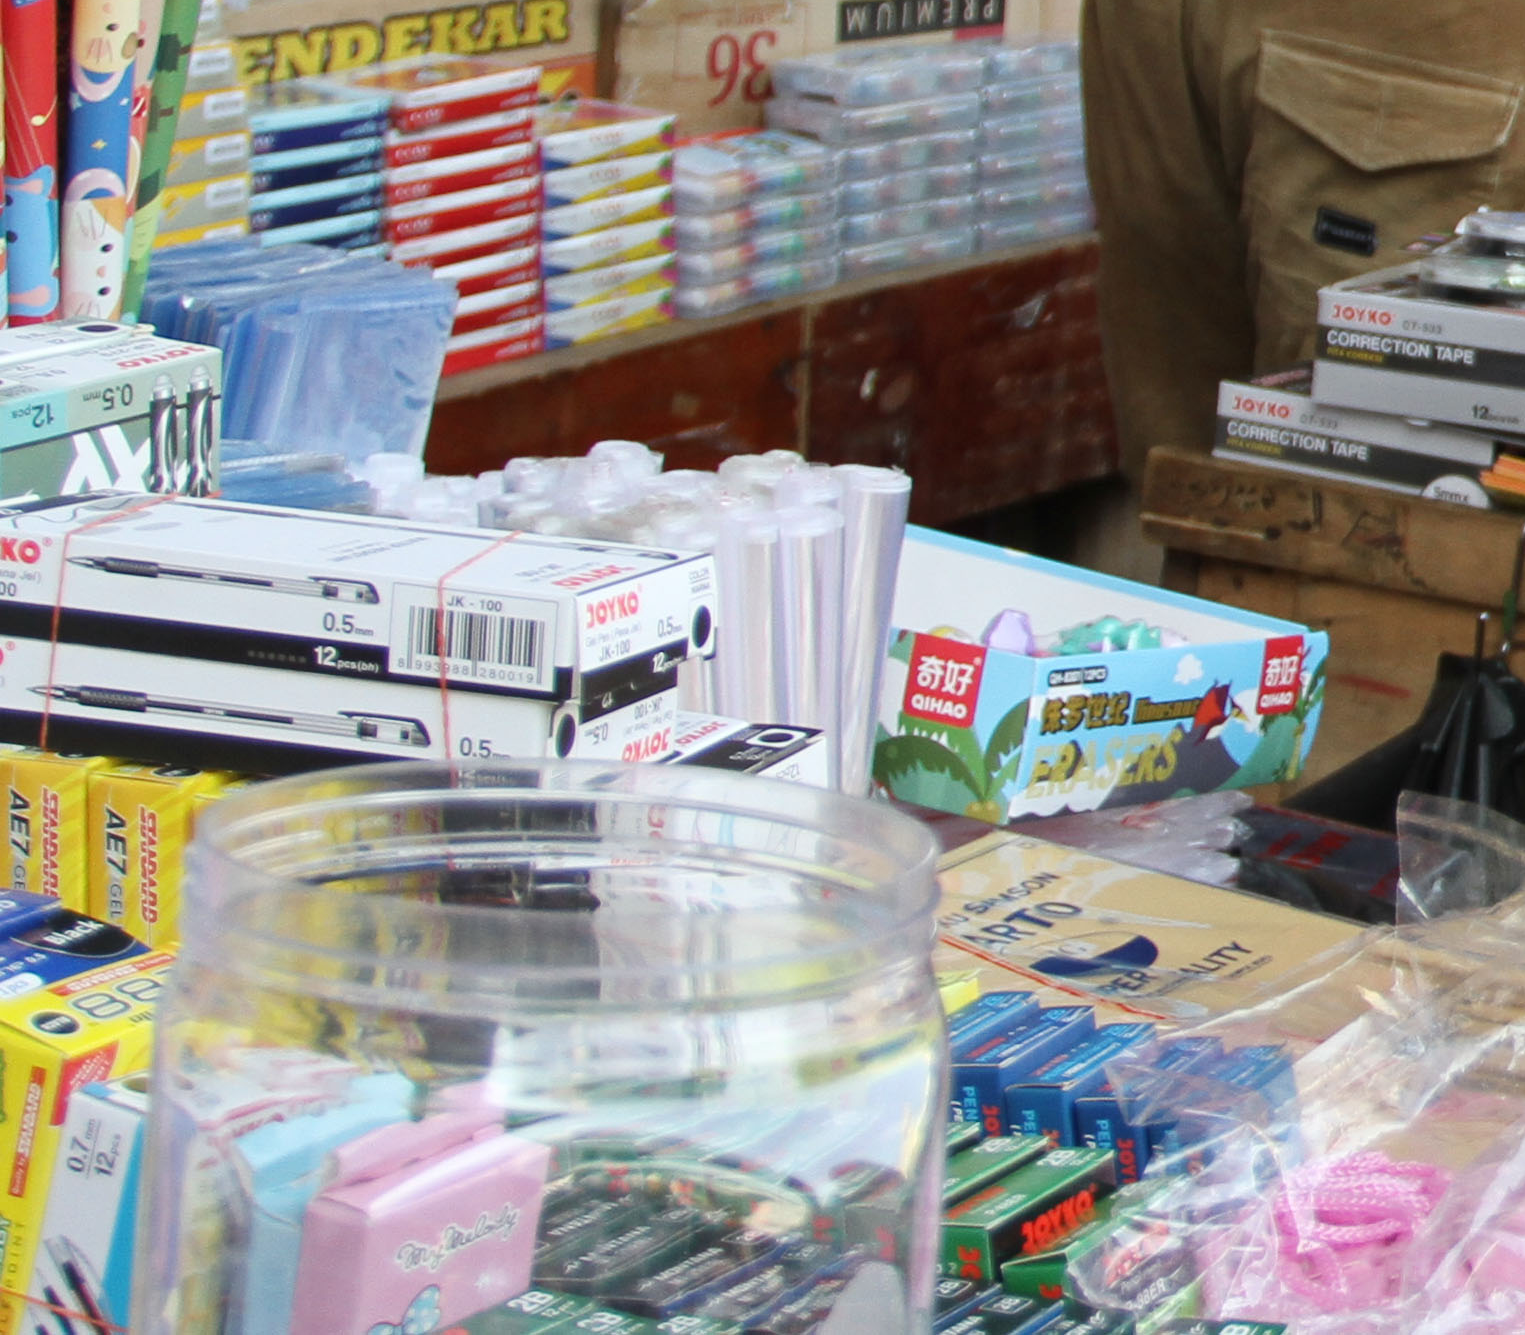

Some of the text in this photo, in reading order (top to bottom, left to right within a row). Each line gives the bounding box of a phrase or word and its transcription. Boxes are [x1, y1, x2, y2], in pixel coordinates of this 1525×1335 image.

[1332, 303, 1392, 327] JOYKO
[1326, 329, 1475, 364] CORRECTION TAPE
[1232, 395, 1290, 419] JOYKO
[1226, 420, 1369, 462] CORRECTION TAPE
[322, 612, 375, 637] 0.5mm
[585, 590, 640, 629] JOYKO
[917, 653, 974, 697] 奇好
[1264, 653, 1300, 687] 奇好
[911, 694, 968, 719] QIHAO
[1260, 690, 1293, 709] QIHAO
[1025, 725, 1186, 800] ERASERS
[9, 784, 33, 890] AE7 GE
[104, 803, 128, 876] AE7
[138, 803, 159, 924] STANDARD
[43, 918, 105, 946] Black
[959, 900, 1083, 948] ARTO
[17, 1082, 42, 1159] STANDARD
[395, 1240, 445, 1274] My
[441, 1201, 523, 1251] Melody
[1020, 1189, 1097, 1255] JOYKO
[505, 1289, 555, 1314] 2B
